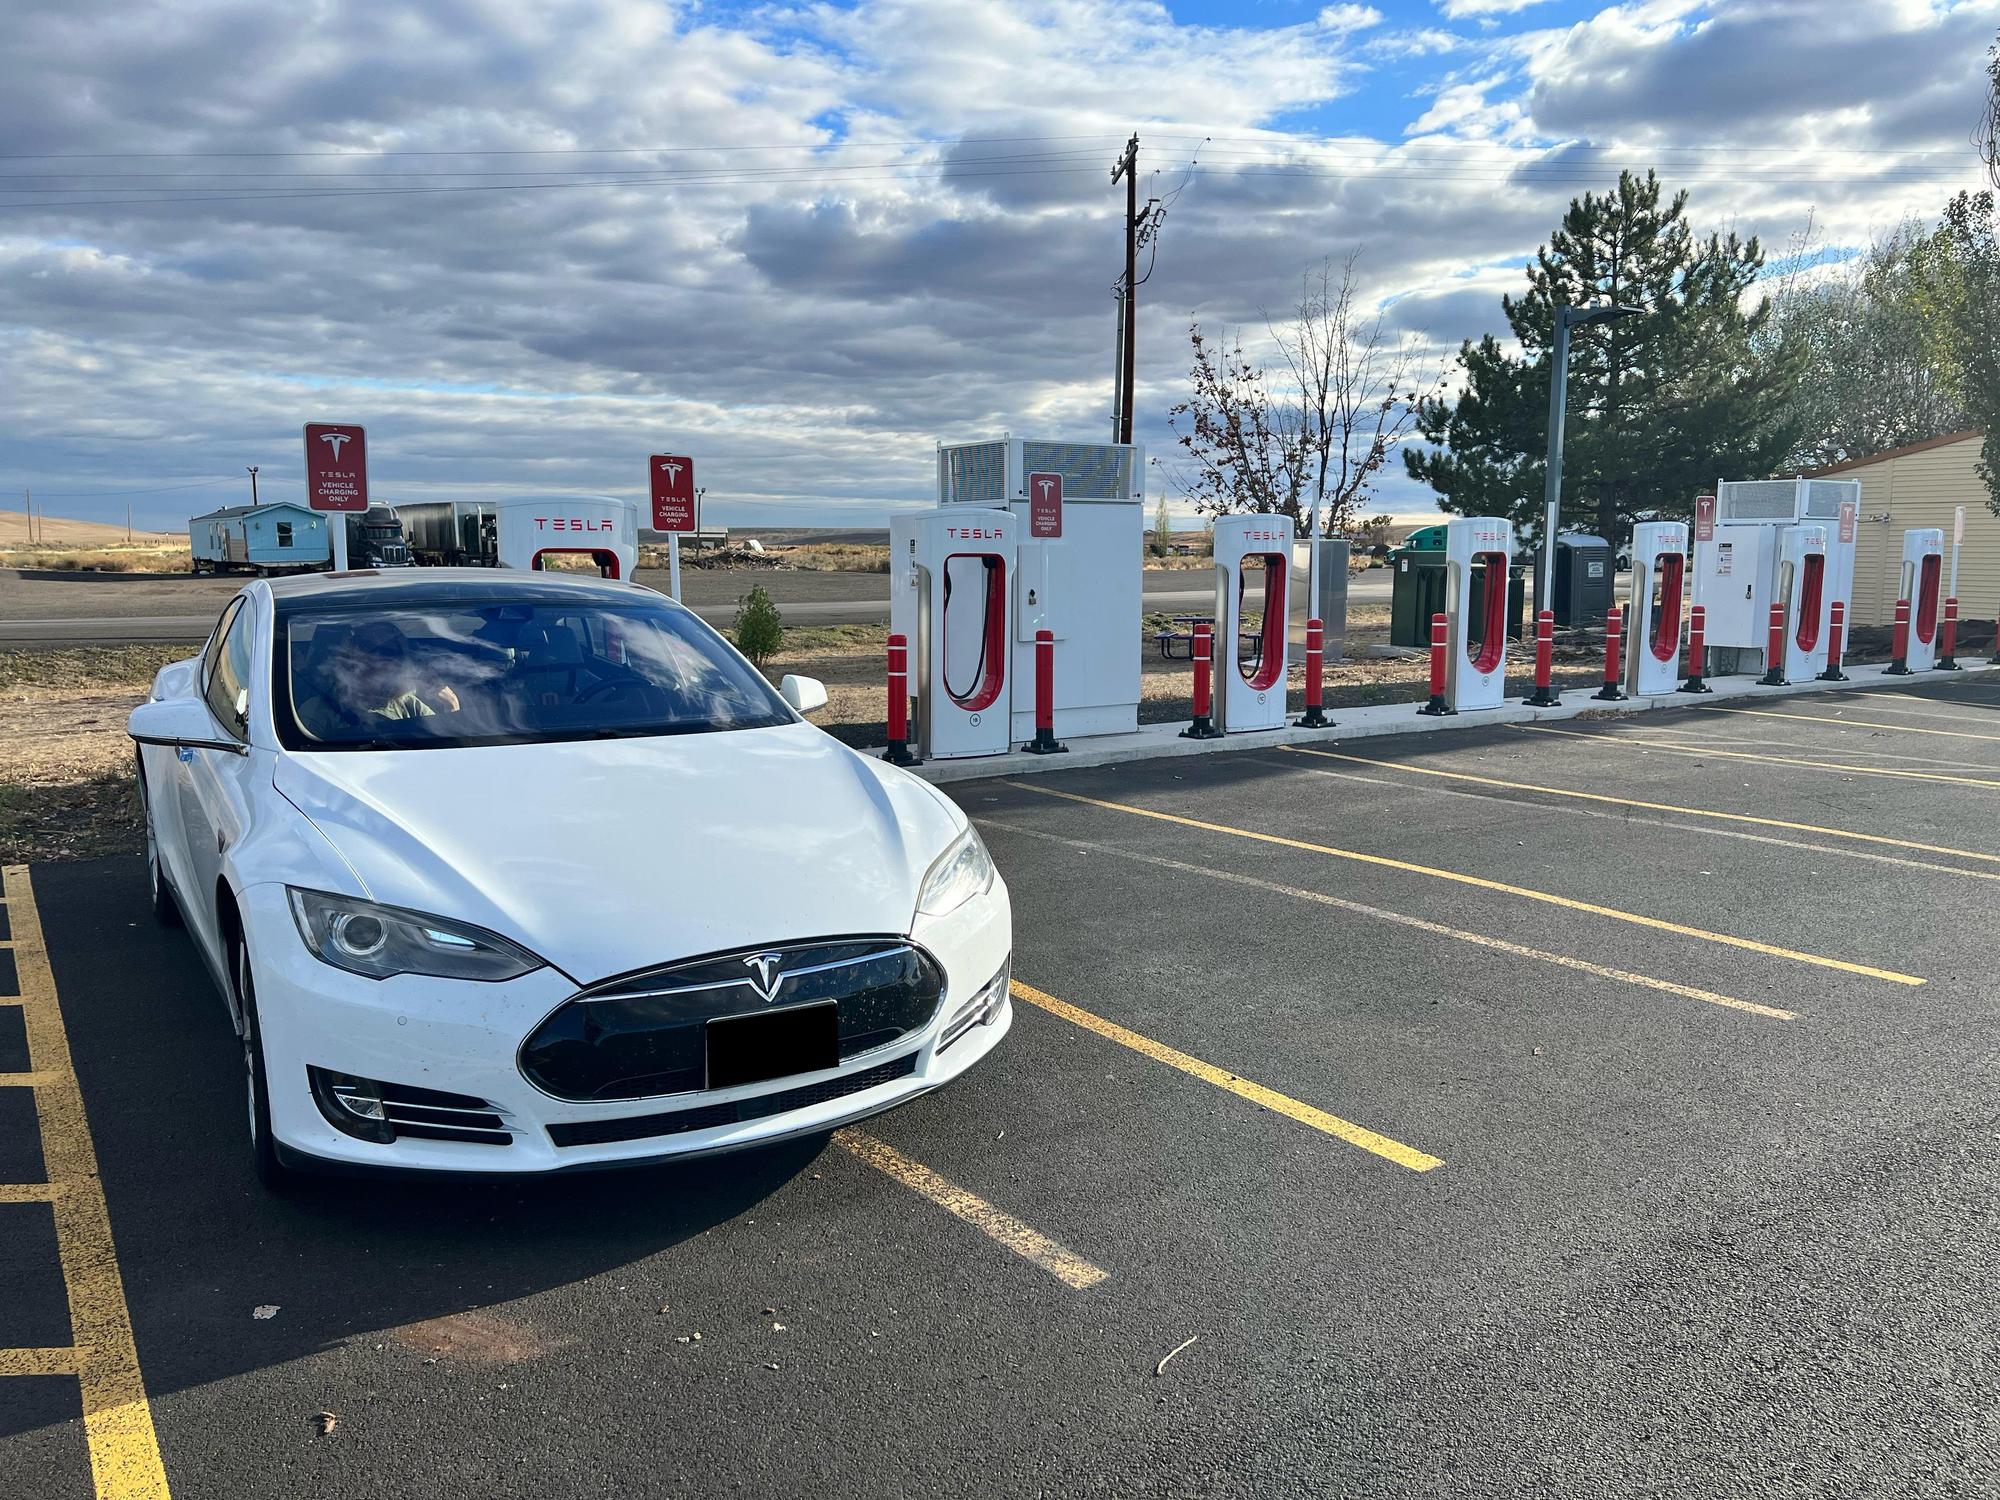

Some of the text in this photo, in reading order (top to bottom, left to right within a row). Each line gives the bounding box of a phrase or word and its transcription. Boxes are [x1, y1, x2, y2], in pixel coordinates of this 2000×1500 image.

[318, 488, 359, 496] CHARGING
[534, 518, 613, 531] TESLA
[947, 528, 1003, 539] TESLA
[1243, 531, 1285, 540] TESLA
